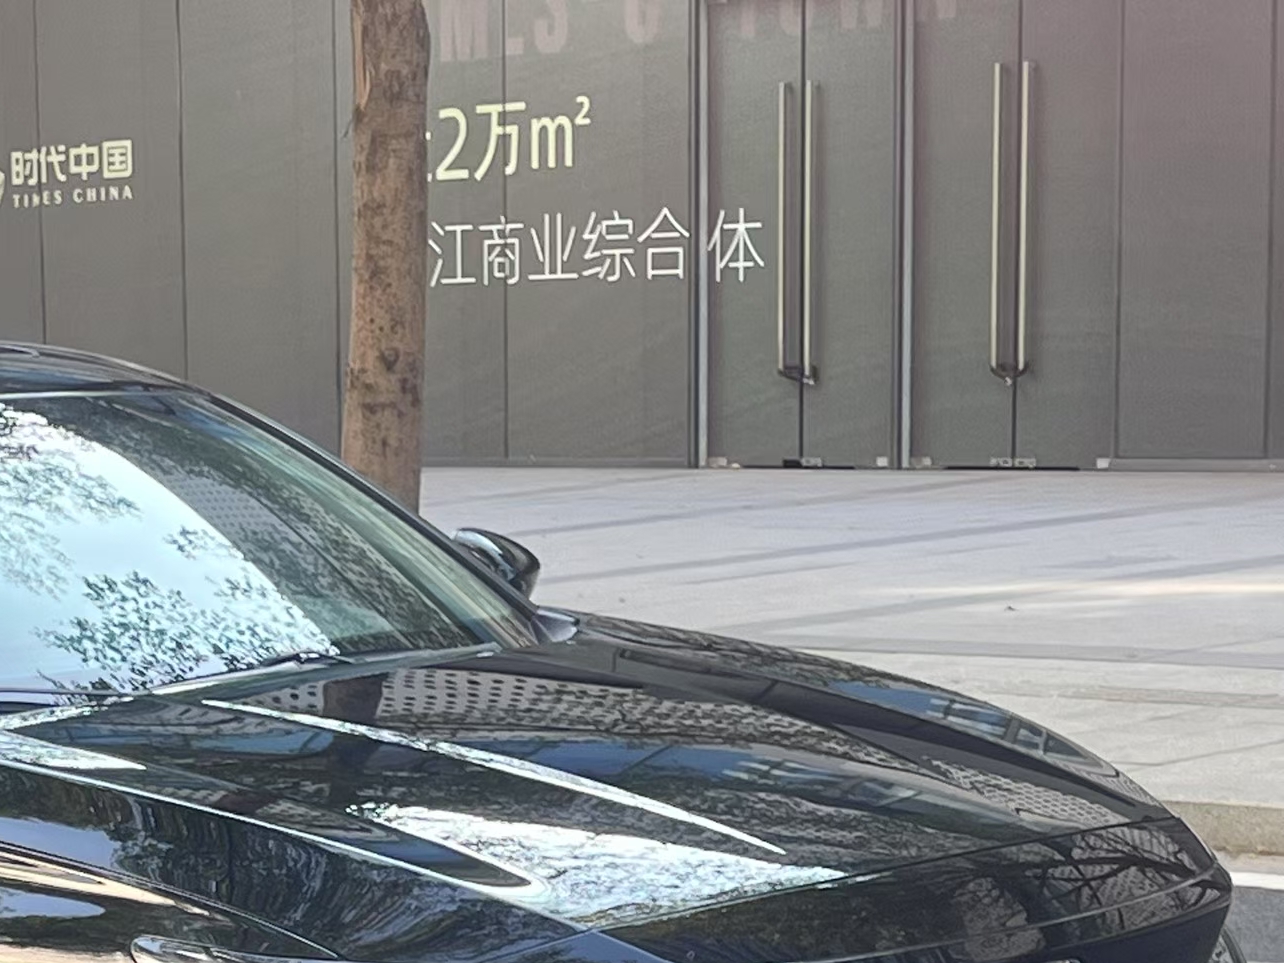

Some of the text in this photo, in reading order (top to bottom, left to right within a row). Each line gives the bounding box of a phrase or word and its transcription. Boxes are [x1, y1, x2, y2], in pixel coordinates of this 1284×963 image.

[10, 139, 133, 186] 时代中国
[425, 95, 591, 183] 2万m²
[13, 185, 133, 208] TIMES CHINA
[428, 206, 765, 288] 江商业综合体
